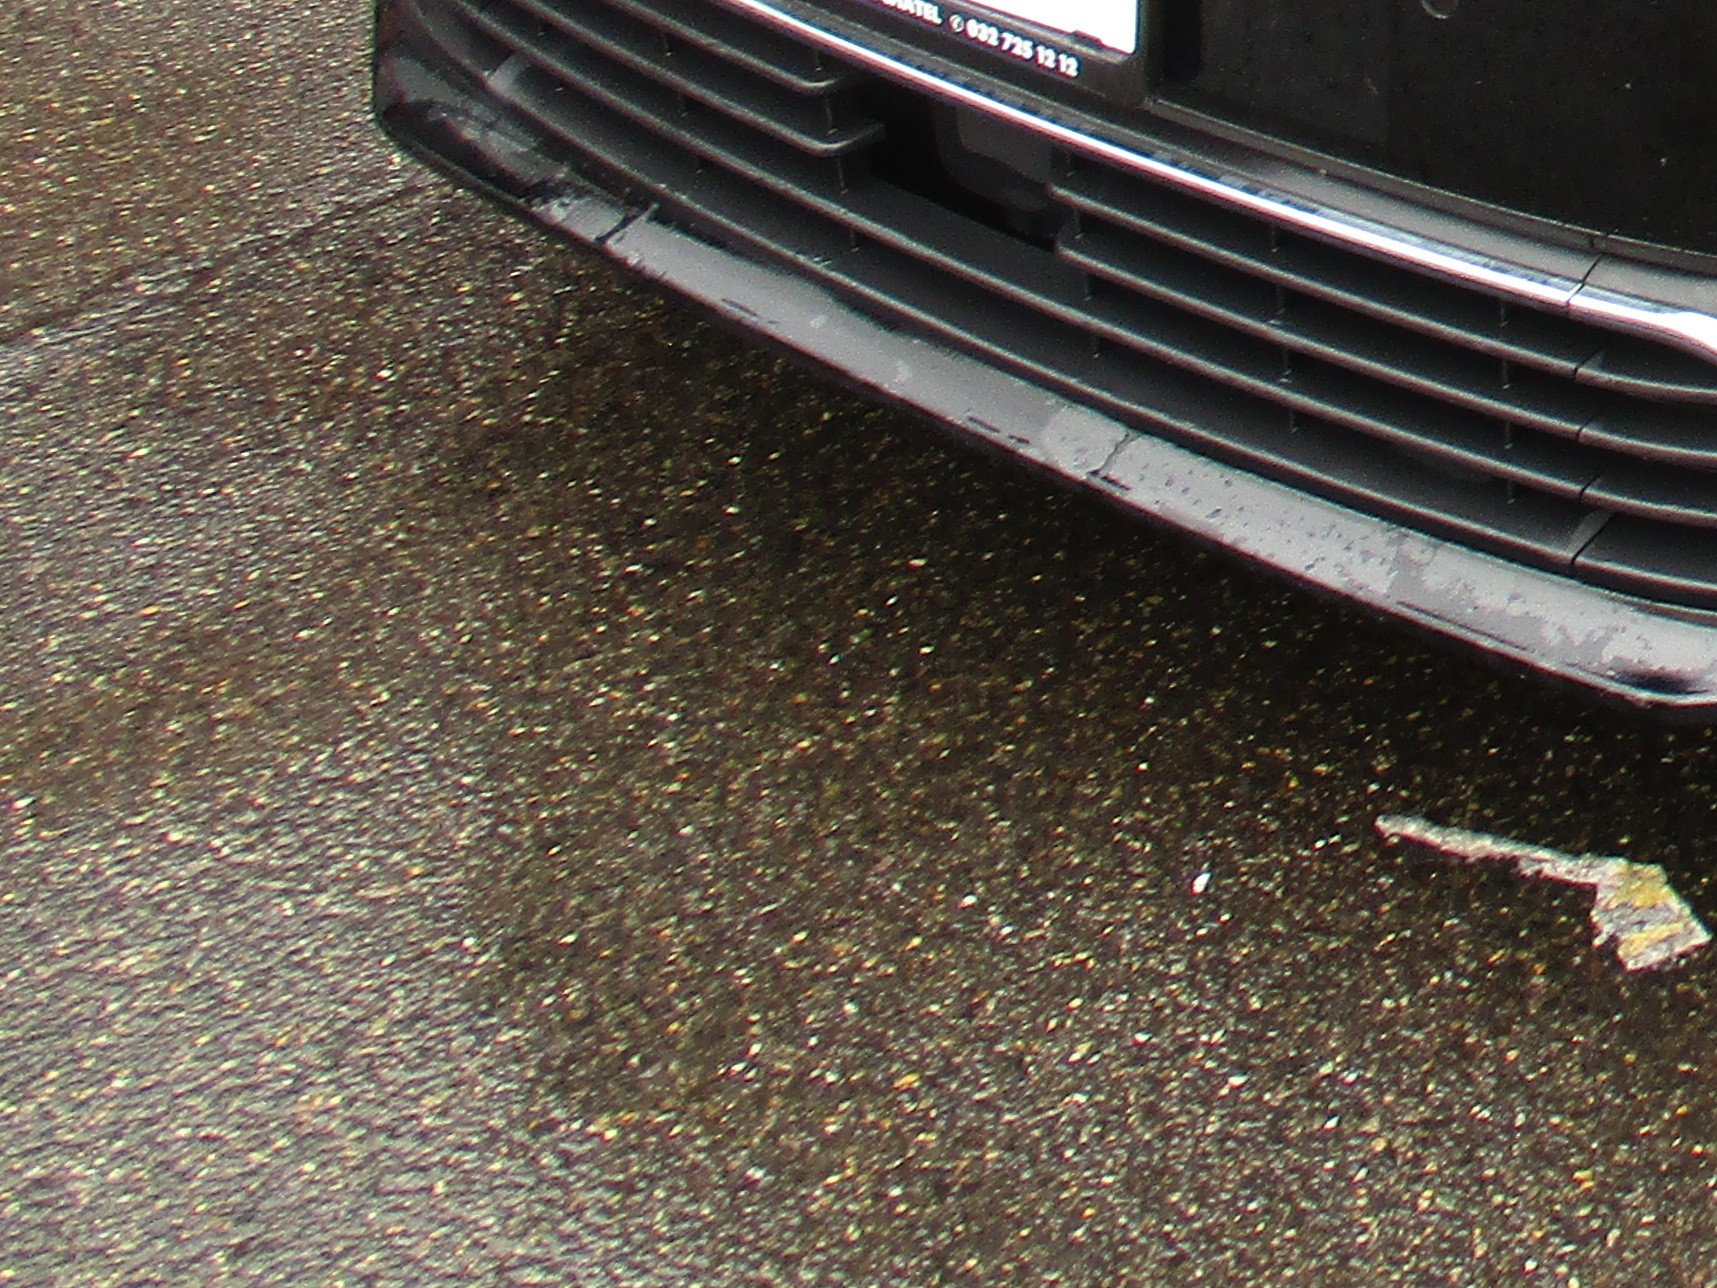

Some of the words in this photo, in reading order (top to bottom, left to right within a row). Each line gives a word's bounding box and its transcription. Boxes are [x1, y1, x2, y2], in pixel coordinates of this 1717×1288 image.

[965, 17, 1000, 48] 032
[1001, 31, 1034, 61] 725
[1036, 44, 1057, 70] 12
[1058, 52, 1080, 79] 12
